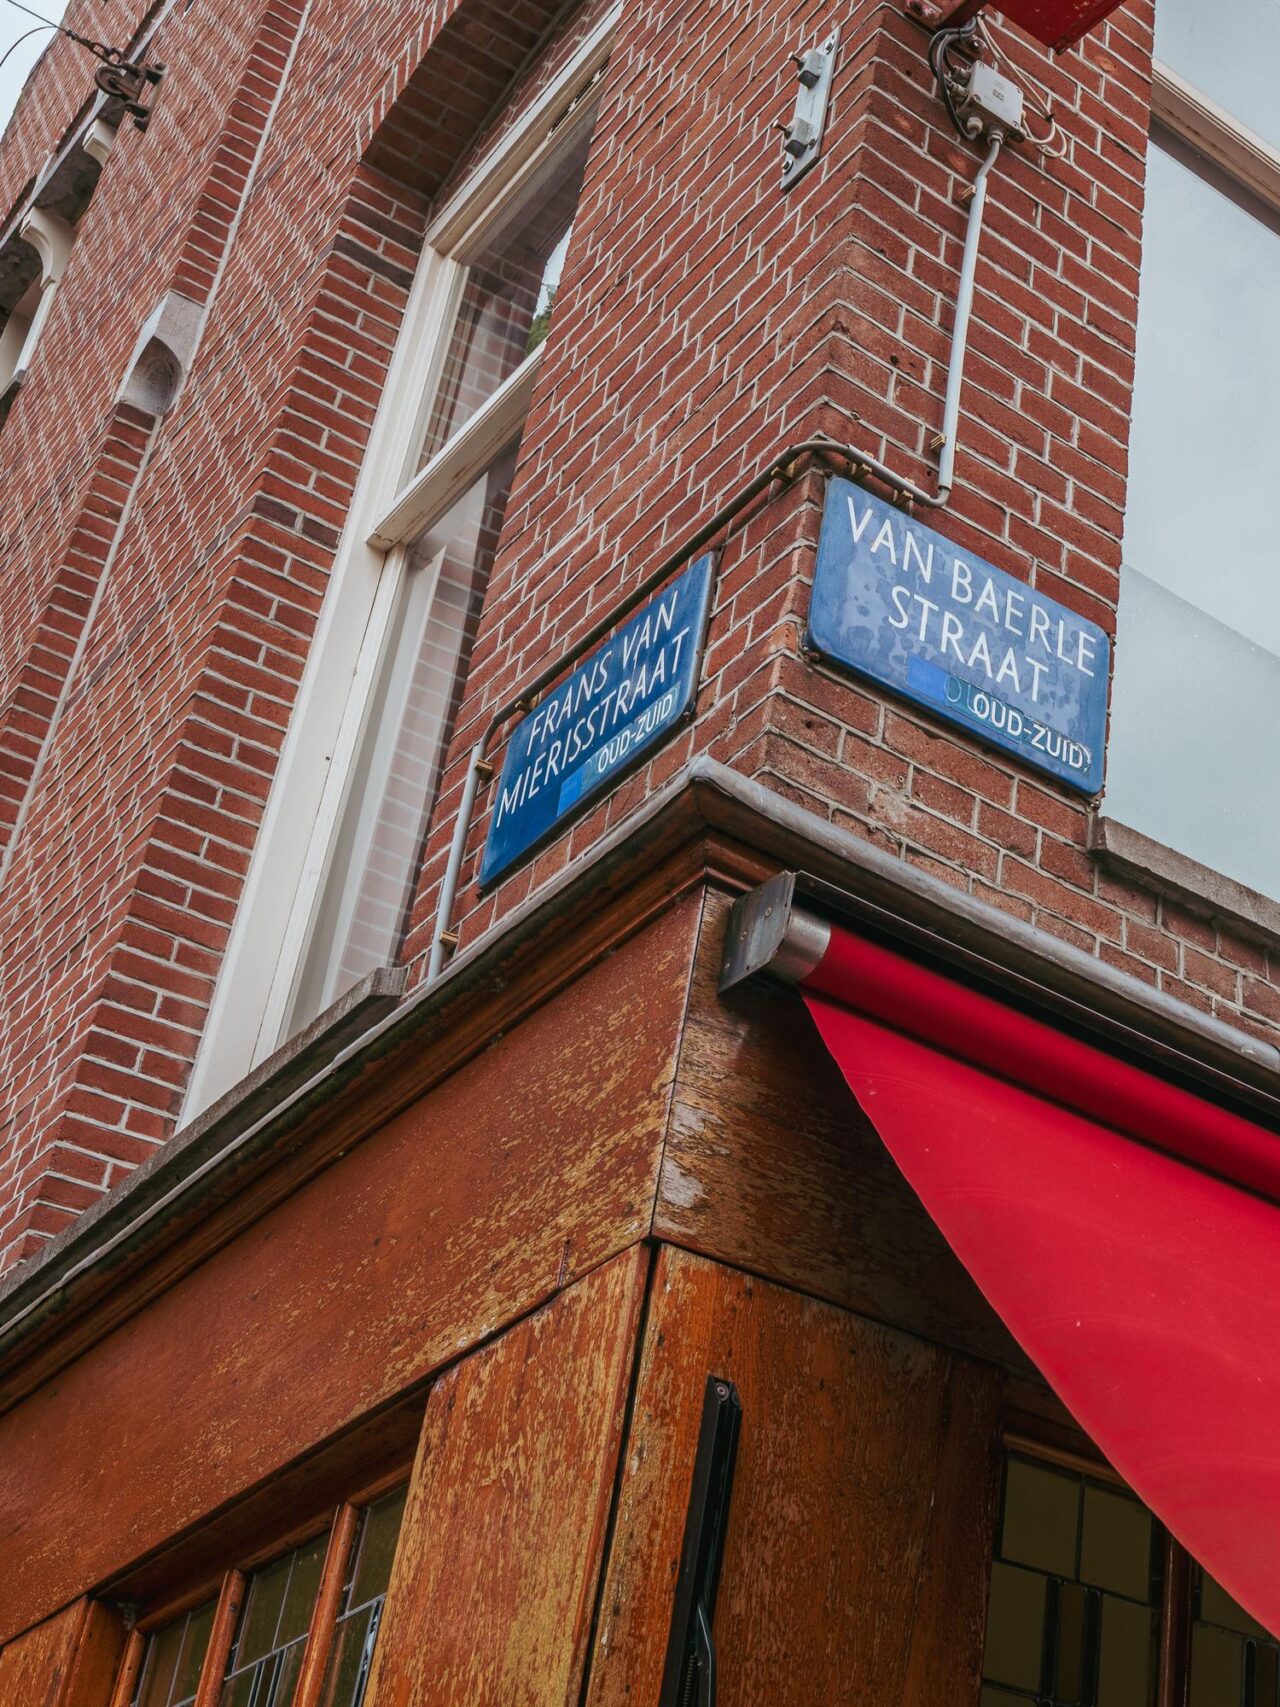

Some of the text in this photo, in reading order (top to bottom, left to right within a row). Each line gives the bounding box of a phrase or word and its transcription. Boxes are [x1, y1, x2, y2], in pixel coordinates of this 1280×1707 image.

[847, 496, 1096, 678] VAN BAERLE
[888, 585, 1049, 703] STRAAT
[496, 627, 690, 828] MIERISSTRAAT
[526, 590, 678, 757] FRANS VAN
[597, 693, 673, 774] OUD-ZUID
[973, 692, 1084, 770] OUD-ZUID
